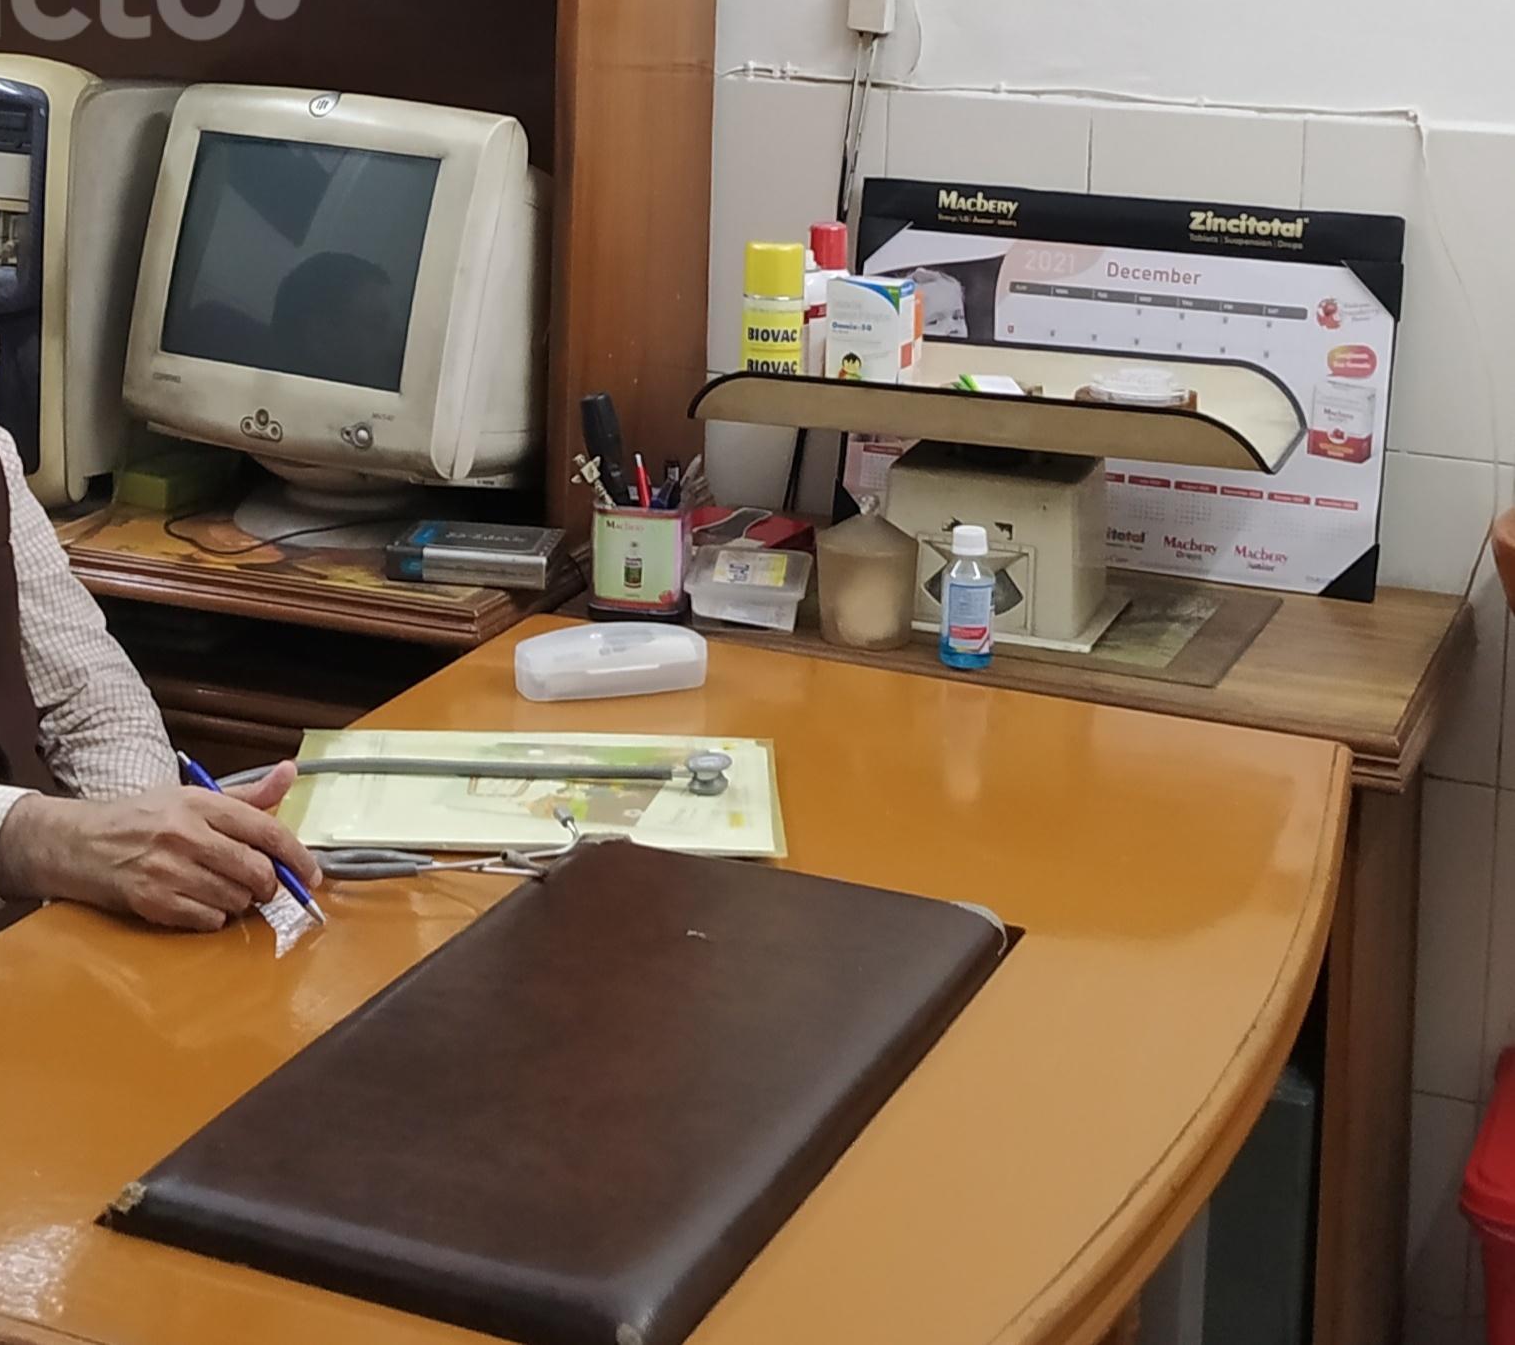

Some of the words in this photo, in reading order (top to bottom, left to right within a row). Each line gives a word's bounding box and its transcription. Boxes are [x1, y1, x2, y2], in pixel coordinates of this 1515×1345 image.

[1189, 211, 1304, 238] Zincitotal
[1024, 250, 1076, 273] 2021
[1106, 261, 1202, 285] December
[747, 327, 798, 343] BIOVAC
[746, 358, 798, 375] BIOVAC
